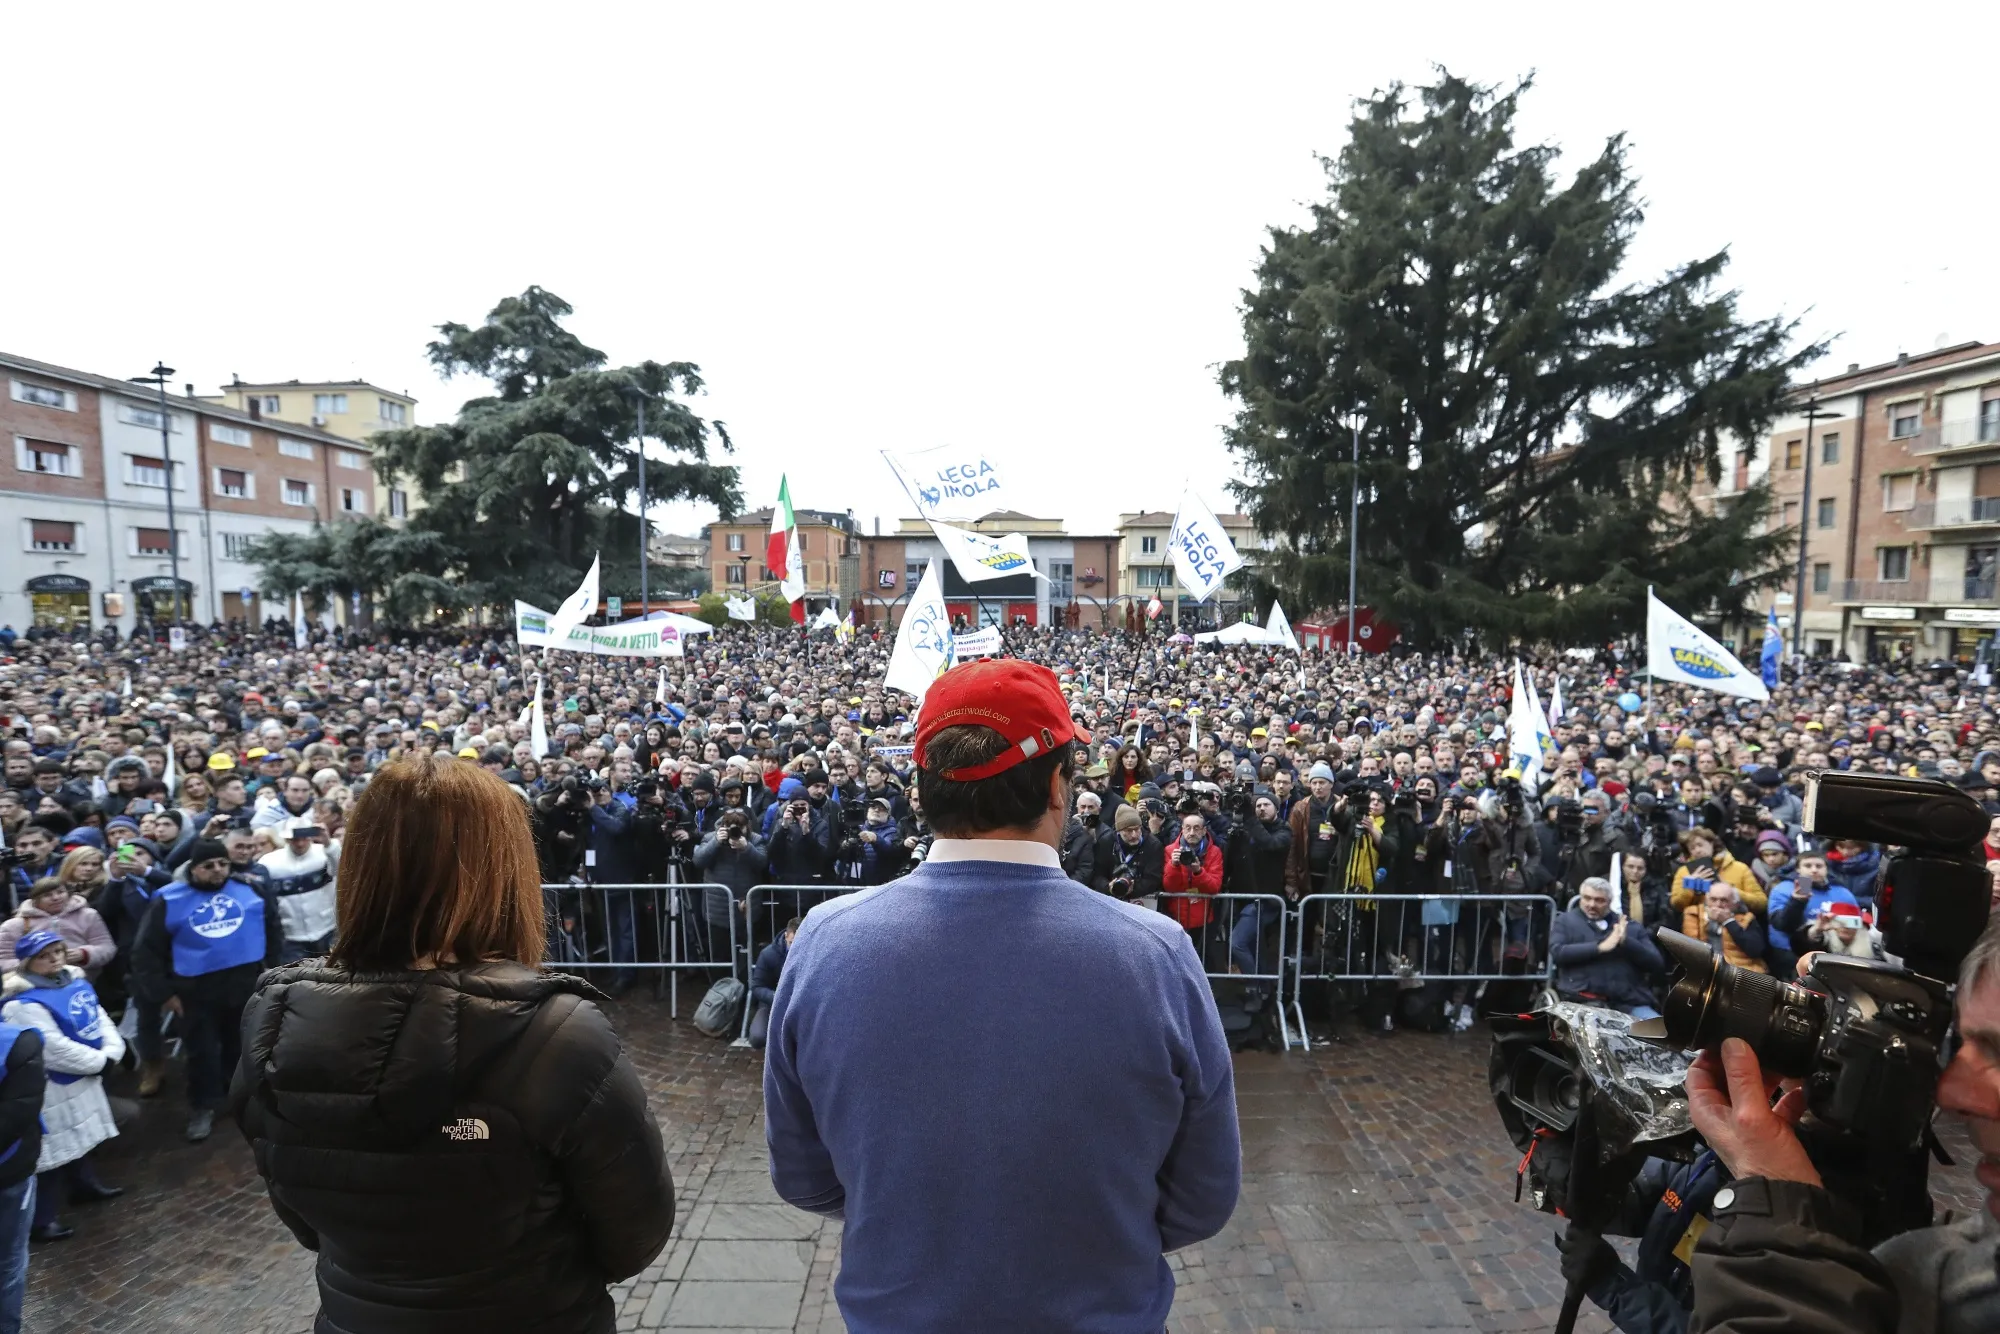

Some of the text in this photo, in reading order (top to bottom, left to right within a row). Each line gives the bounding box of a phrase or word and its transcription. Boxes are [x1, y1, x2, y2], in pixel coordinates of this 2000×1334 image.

[936, 459, 994, 483] LEGA
[943, 477, 1000, 498] IMOLA
[1180, 533, 1213, 586] IMOLA
[1186, 521, 1225, 577] LEGA
[567, 629, 588, 640] LLA
[619, 636, 628, 649] A
[629, 632, 658, 649] VETTO
[926, 705, 1011, 730] www.ferrariworld.com
[441, 1125, 474, 1133] NORTH
[456, 1118, 474, 1126] THE
[450, 1132, 474, 1140] FACE
